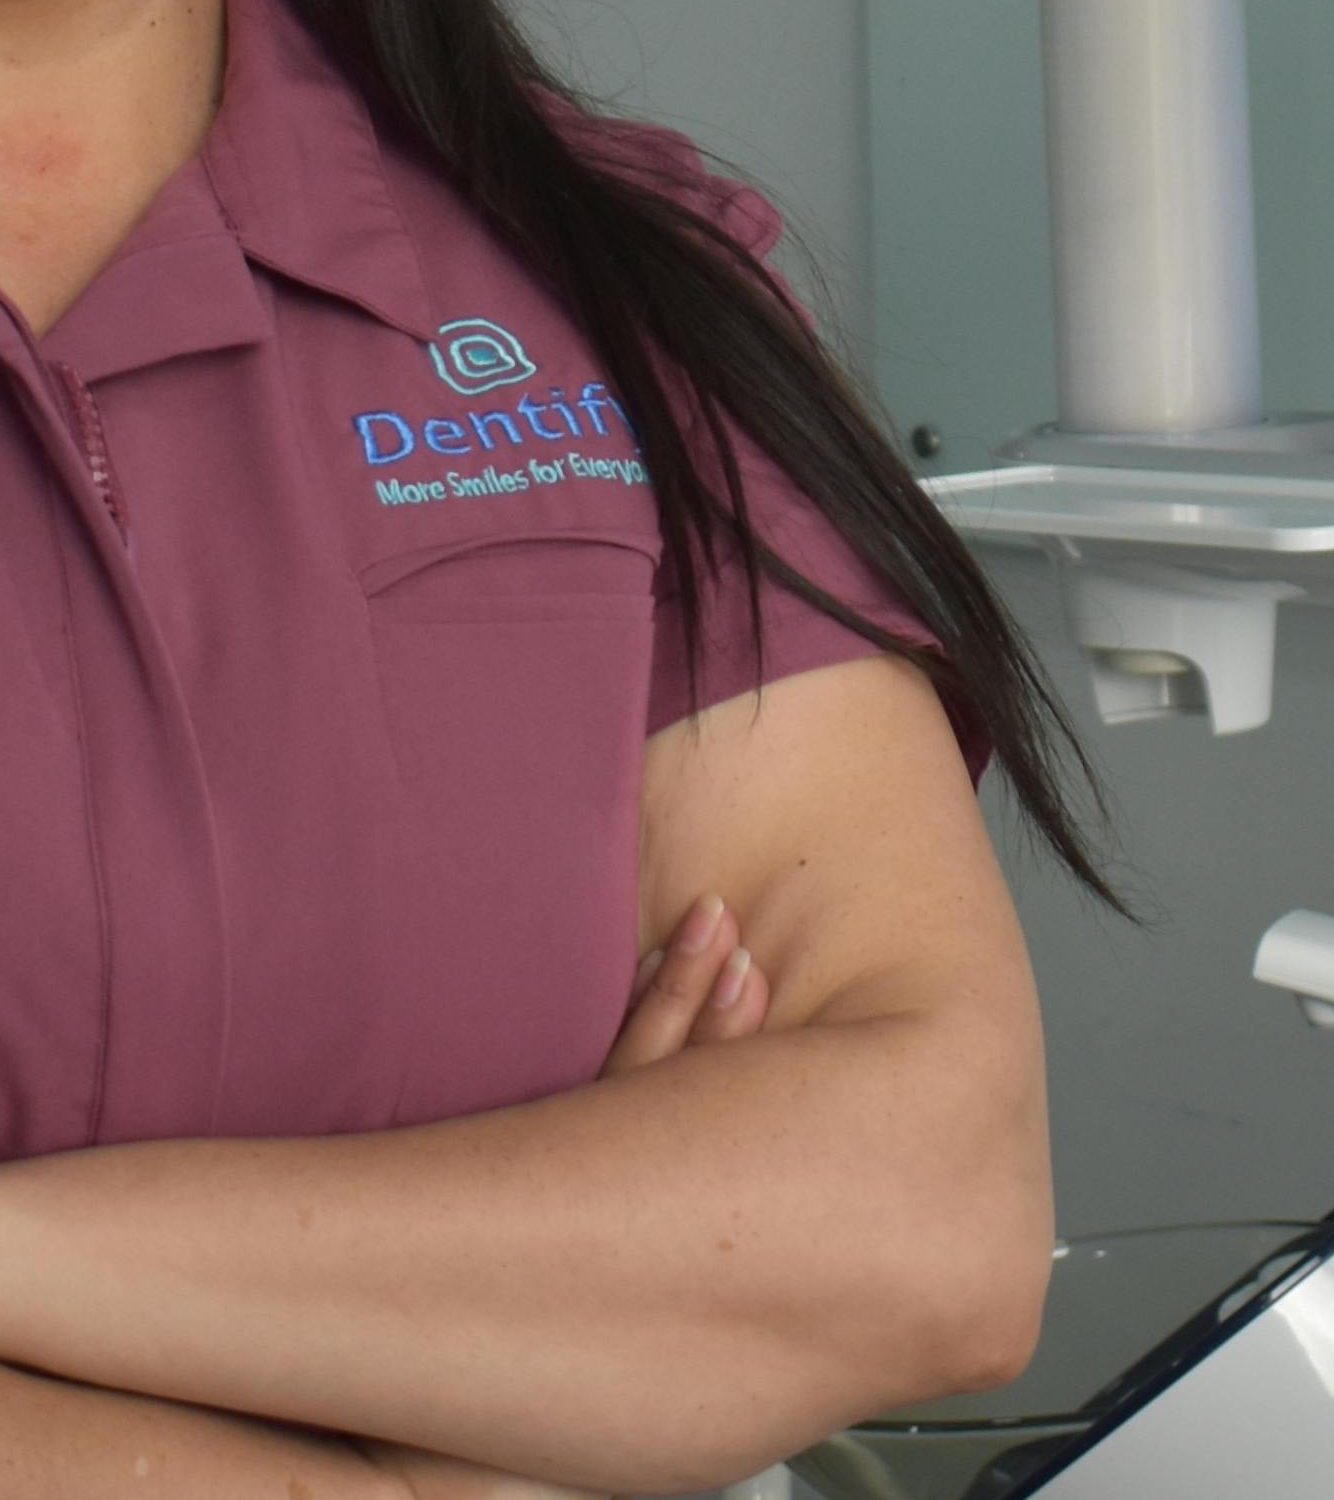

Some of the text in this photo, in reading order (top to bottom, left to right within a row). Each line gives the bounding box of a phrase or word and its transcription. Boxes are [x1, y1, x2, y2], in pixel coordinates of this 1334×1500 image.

[375, 479, 447, 506] More
[447, 466, 529, 498] Smiles
[529, 456, 567, 486] for
